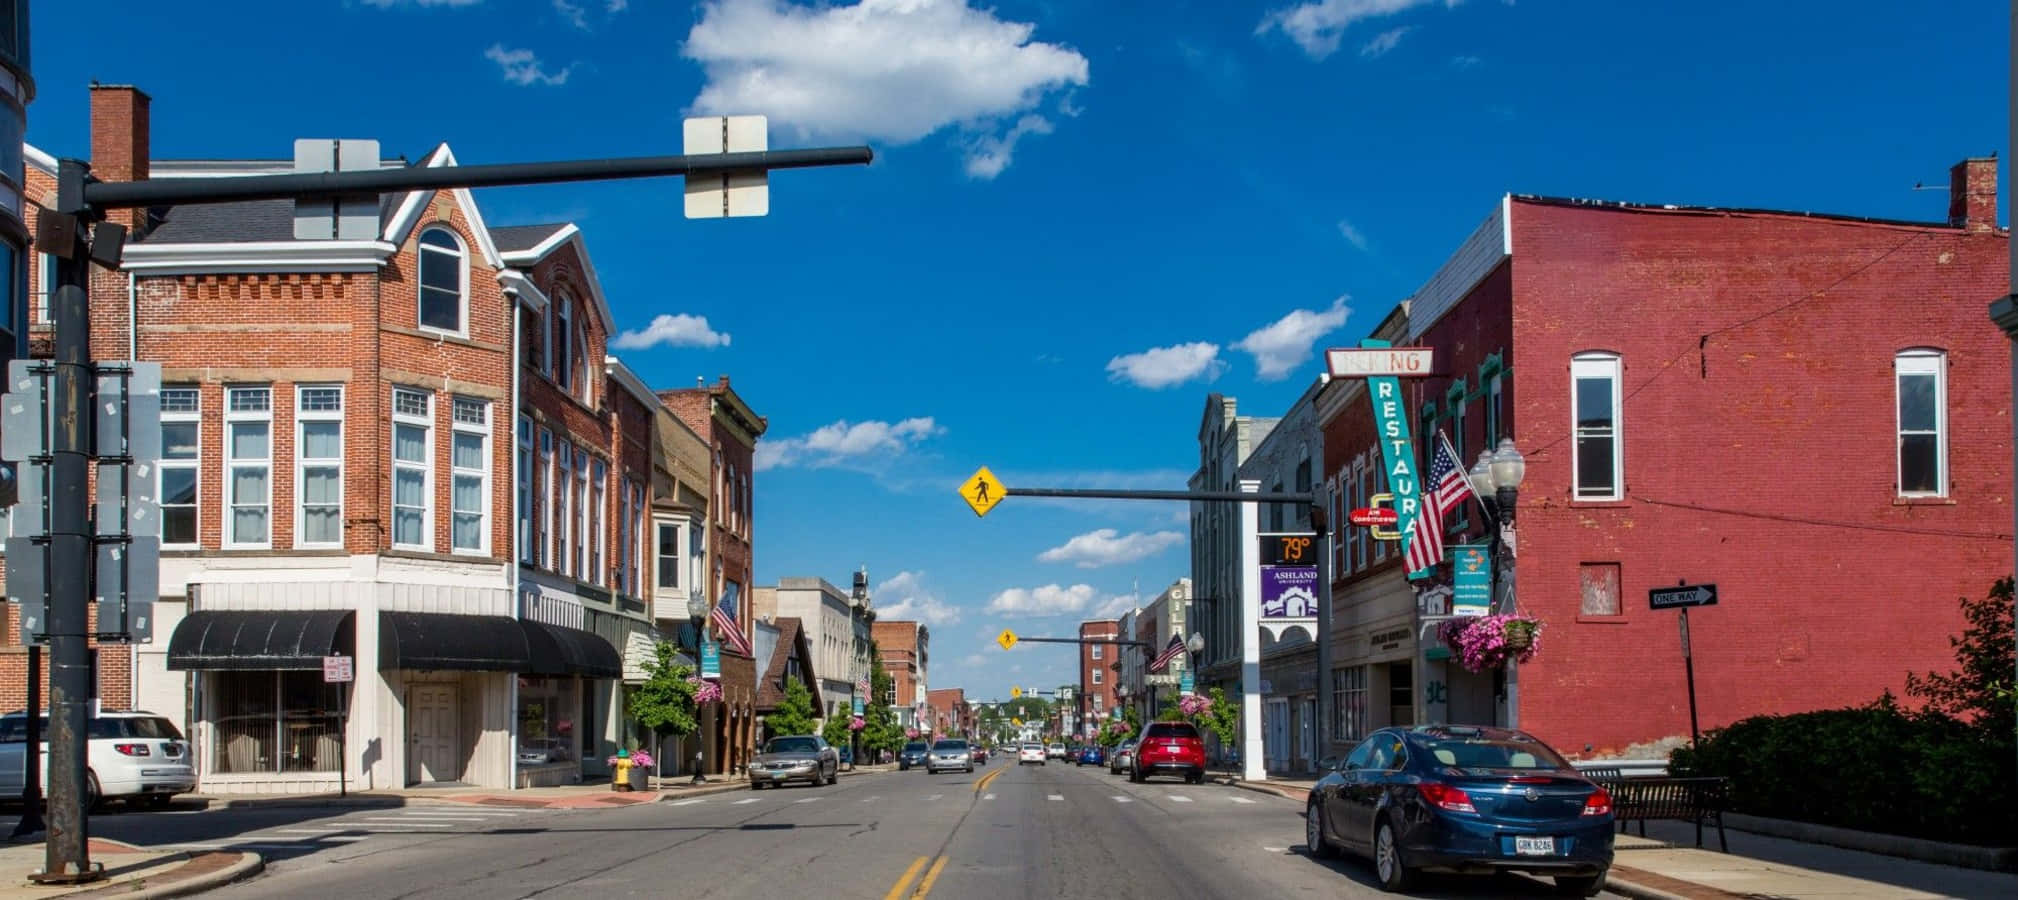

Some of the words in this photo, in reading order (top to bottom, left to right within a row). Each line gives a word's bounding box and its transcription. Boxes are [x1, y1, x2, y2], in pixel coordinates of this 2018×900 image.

[1379, 382, 1416, 546] RESTAURA
[1273, 571, 1318, 580] ASHLAND
[1656, 593, 1679, 604] ONE
[1680, 591, 1698, 602] WAY
